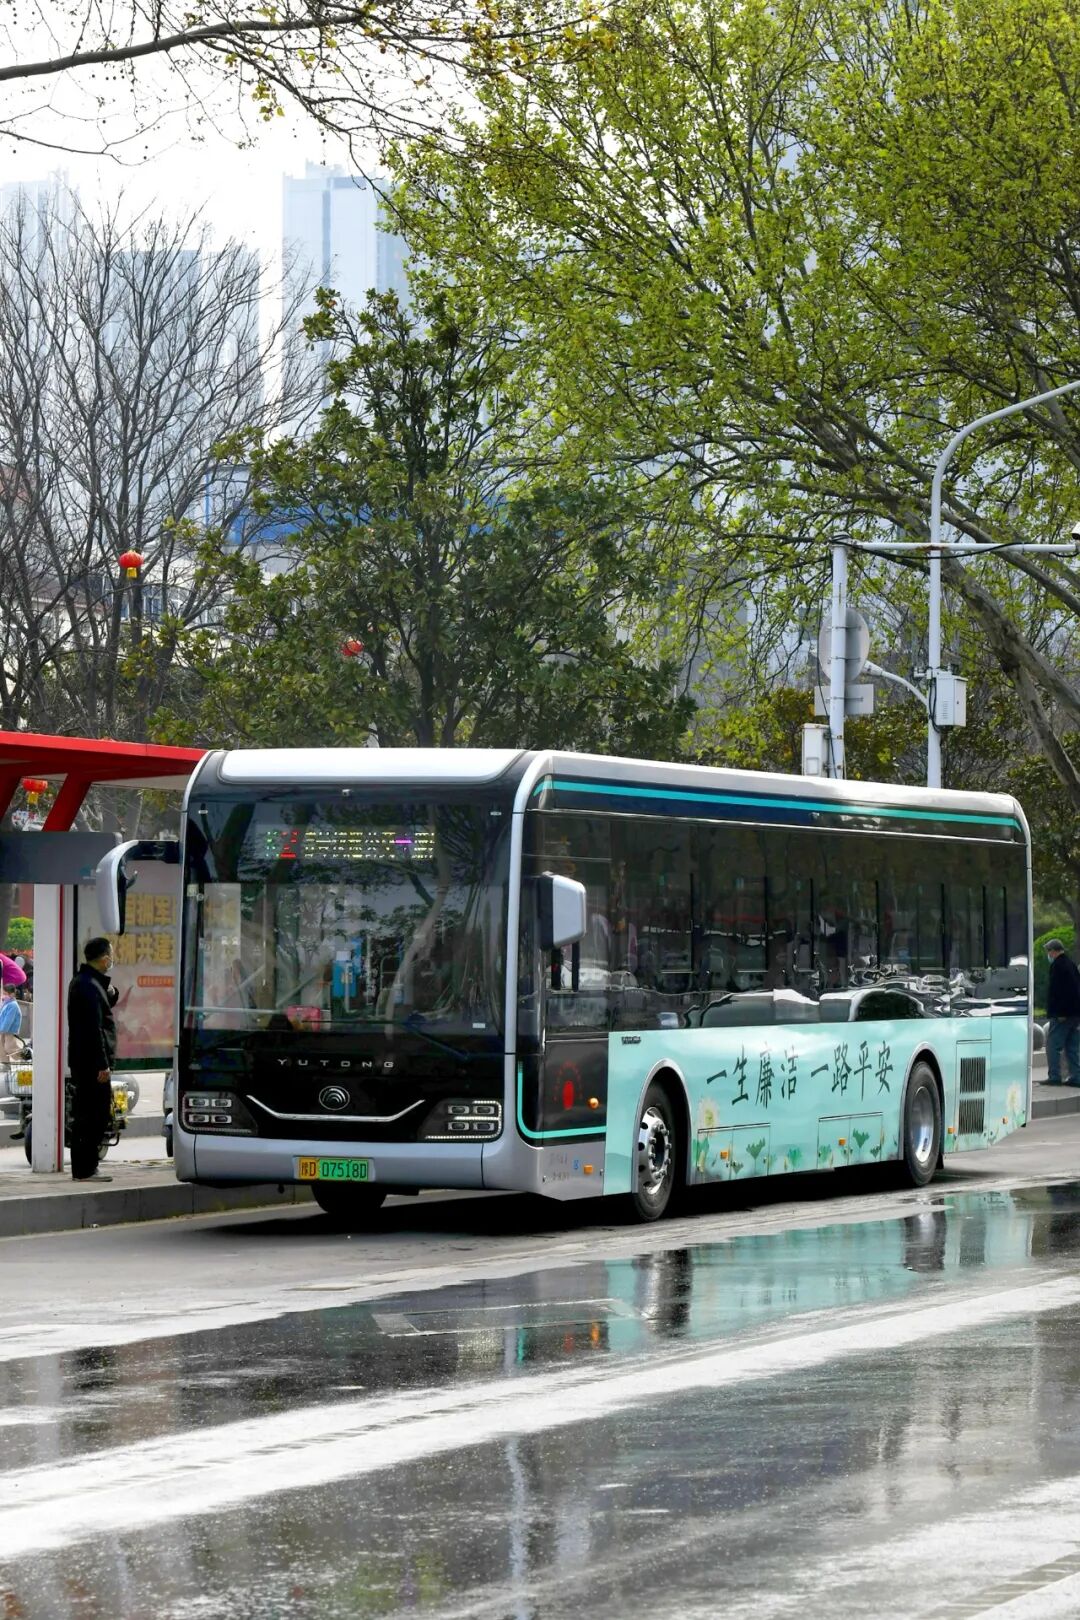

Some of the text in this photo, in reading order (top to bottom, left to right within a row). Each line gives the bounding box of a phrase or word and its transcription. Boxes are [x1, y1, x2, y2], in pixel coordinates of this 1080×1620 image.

[277, 1058, 394, 1068] YUTONG
[706, 1040, 894, 1109] 一生廉洁 一路平安
